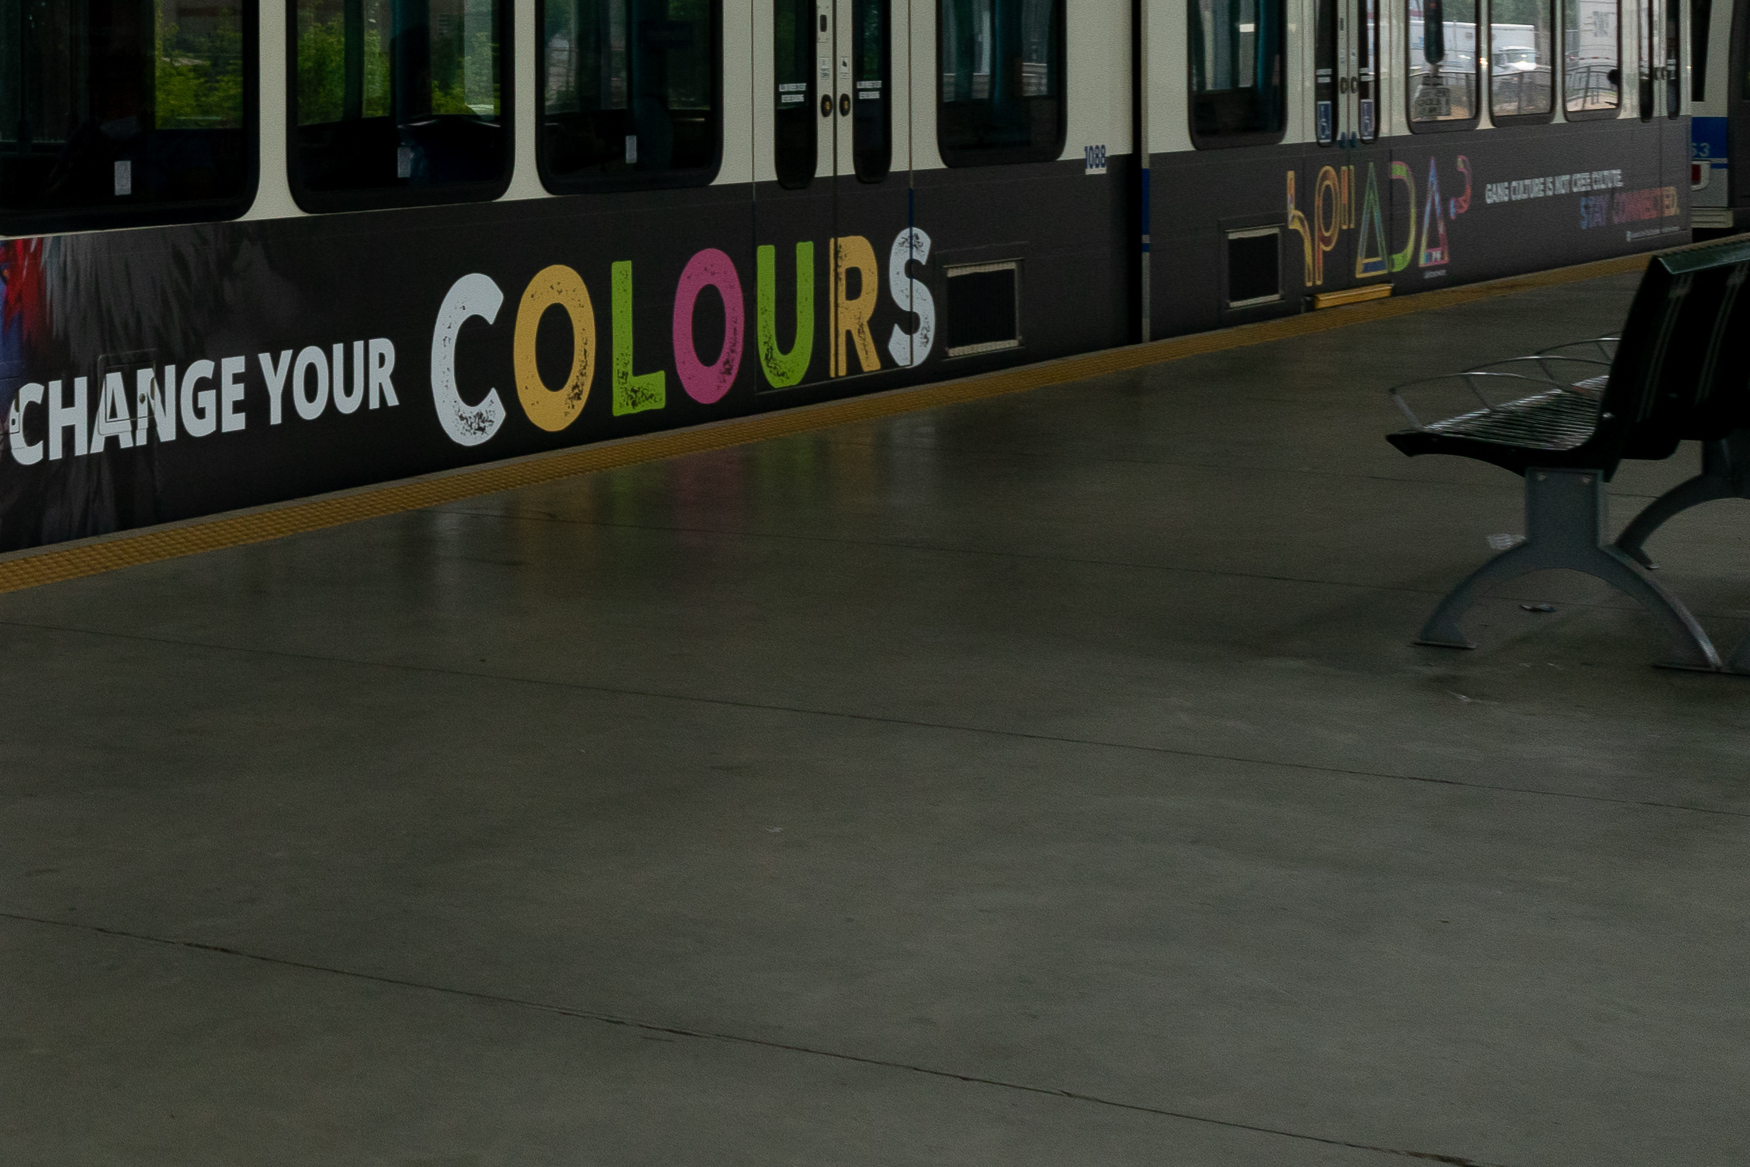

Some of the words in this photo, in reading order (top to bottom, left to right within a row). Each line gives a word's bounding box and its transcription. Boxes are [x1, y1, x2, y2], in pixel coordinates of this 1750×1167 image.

[1084, 145, 1106, 169] 1088
[1485, 181, 1509, 205] GANG
[1510, 177, 1544, 201] CULTURE
[1545, 176, 1554, 196] IS
[1554, 174, 1571, 195] NOT
[1580, 195, 1608, 229] STAY
[9, 355, 246, 466] CHANGE
[257, 337, 400, 428] YOUR
[429, 227, 937, 447] COLOURS
